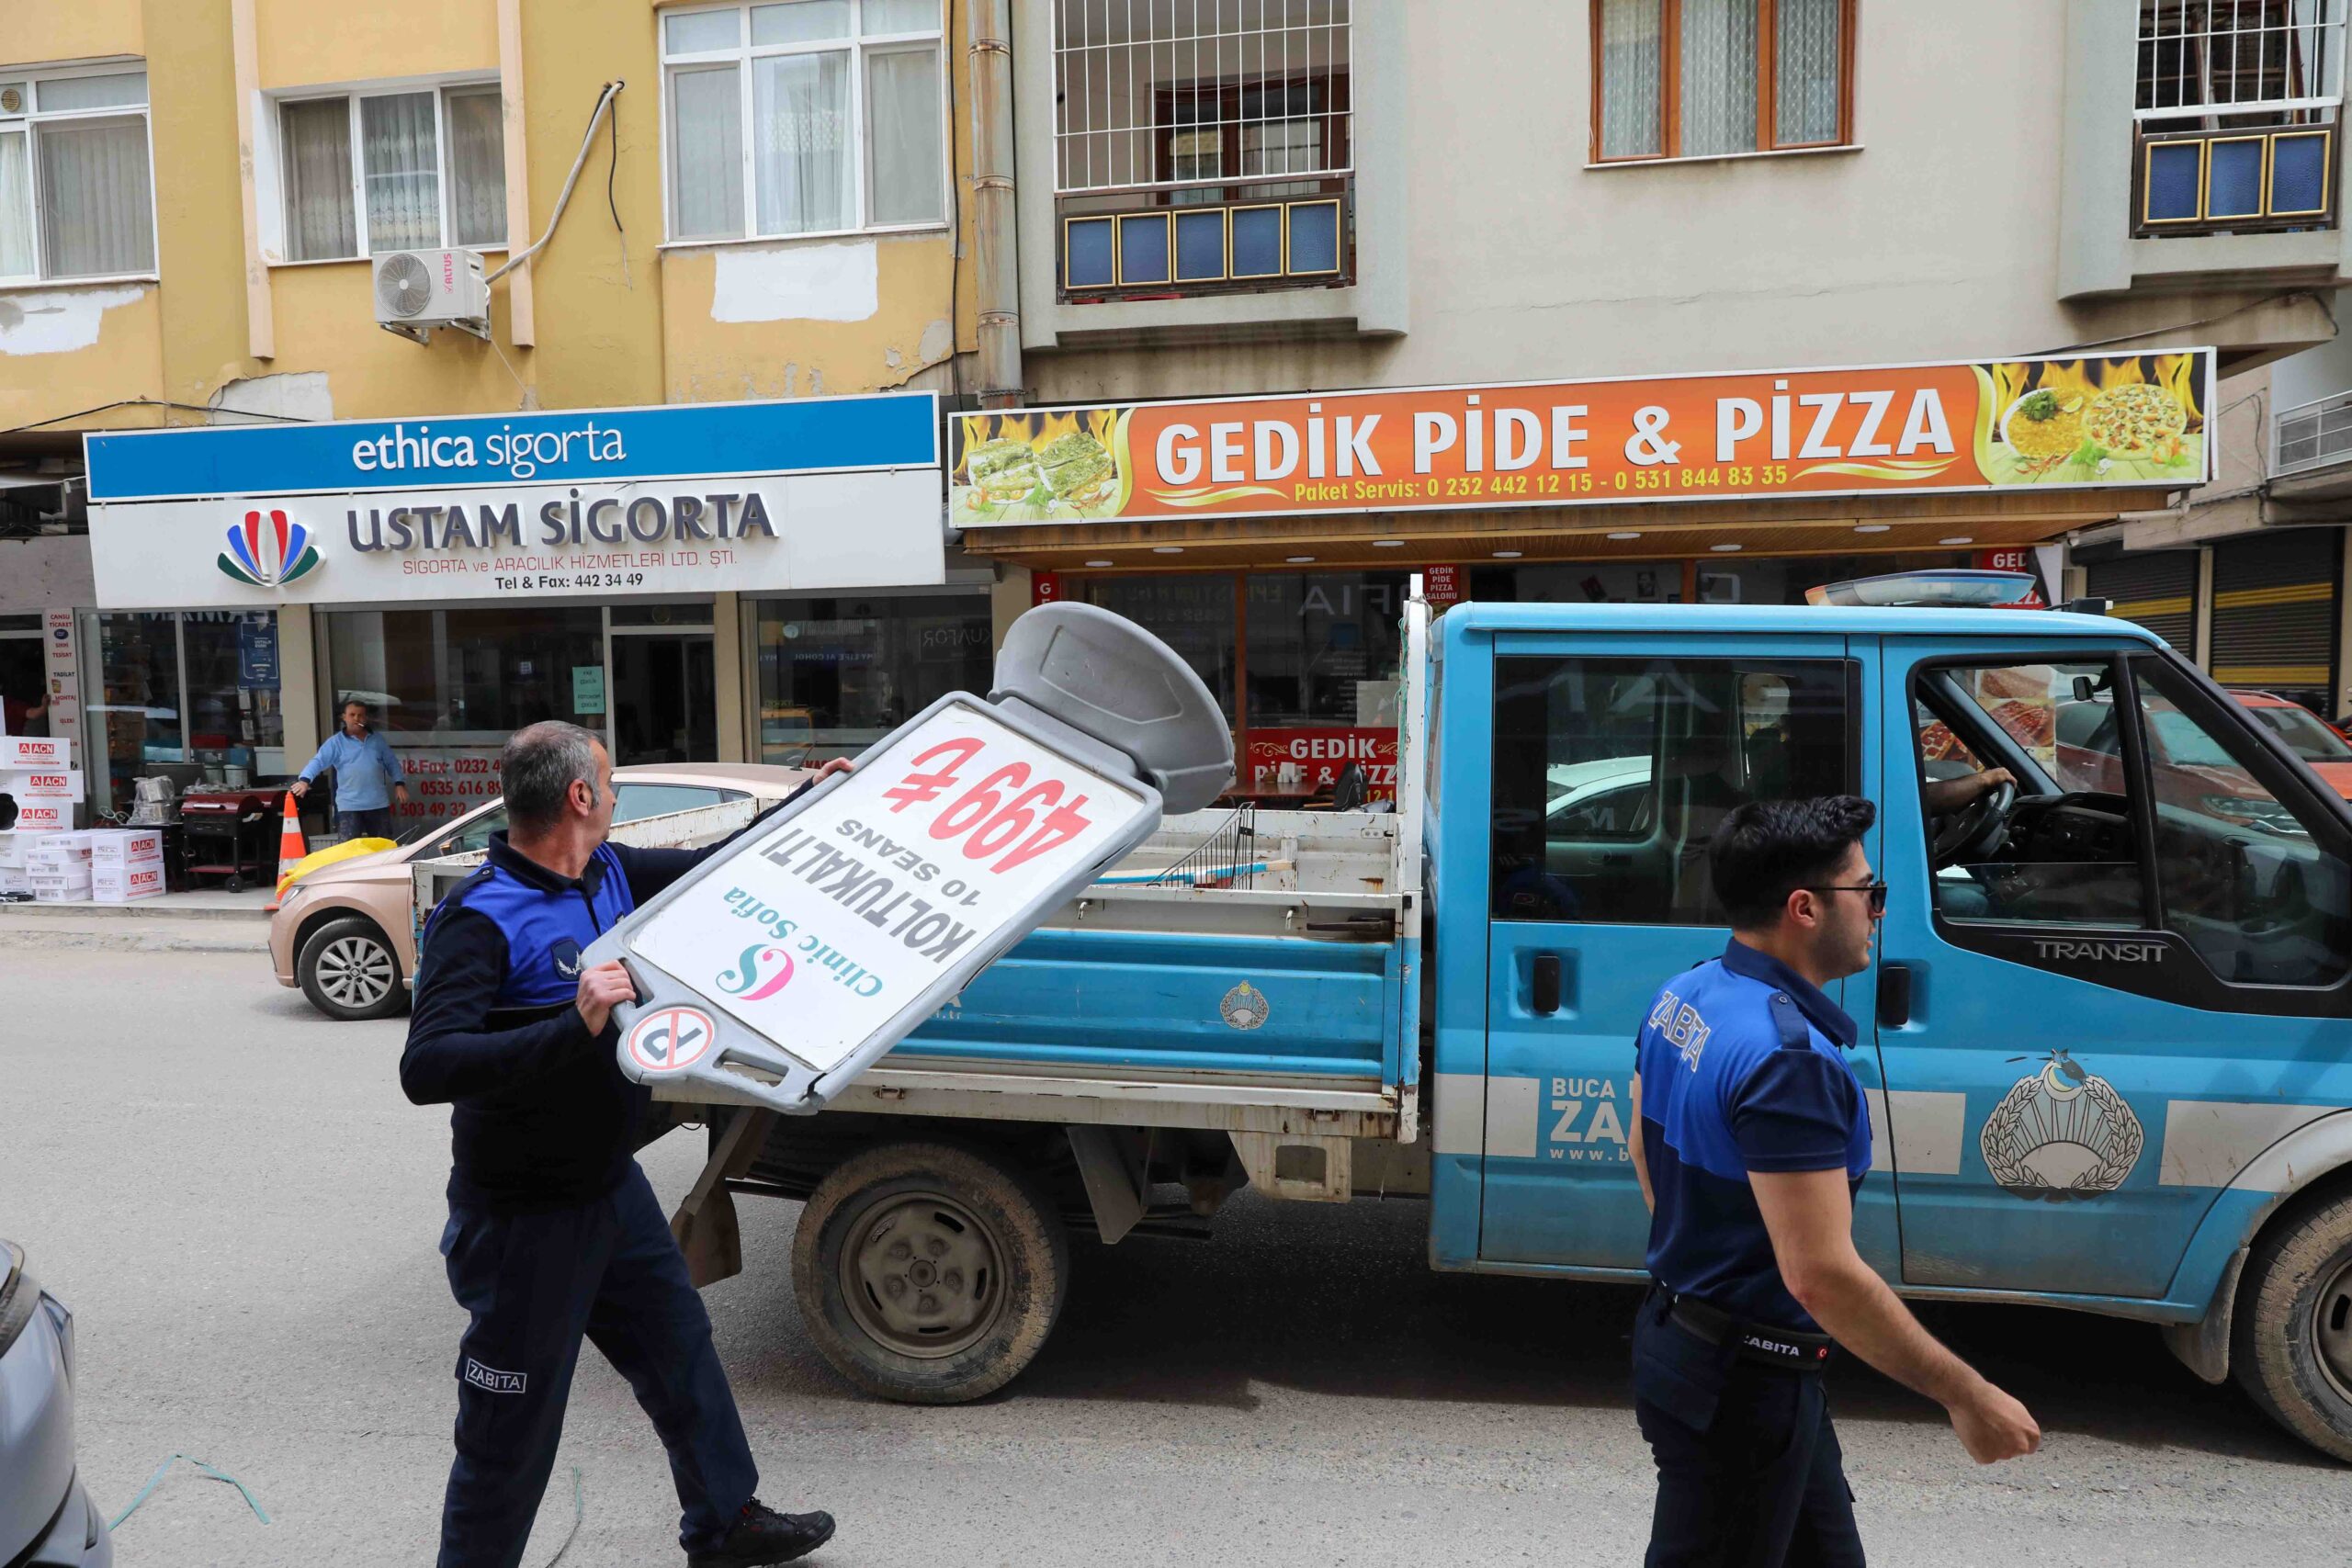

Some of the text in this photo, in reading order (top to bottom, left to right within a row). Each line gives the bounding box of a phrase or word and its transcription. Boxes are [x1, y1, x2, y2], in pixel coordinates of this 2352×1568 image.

[444, 253, 453, 285] ALTUS
[1155, 379, 1956, 486] GEDİK PİDE & PİZZA
[353, 421, 627, 479] ethica sigorta
[1295, 483, 1349, 502] Paket
[1354, 479, 1420, 501] Servis:
[1427, 478, 1439, 497] 0
[1446, 477, 1483, 496] 232
[1490, 476, 1527, 494] 442
[1537, 474, 1559, 493] 12
[1569, 473, 1592, 491] 15
[1614, 471, 1627, 491] 0
[1634, 469, 1671, 489] 531
[1680, 468, 1720, 487] 844
[1727, 467, 1753, 485] 83
[1761, 465, 1787, 484] 35
[347, 488, 780, 552] USTAM SİGORTA
[403, 547, 737, 575] SİGORTA ve ARACILIK HİZMETLERİ LTD. ŞTİ.
[1429, 566, 1454, 575] GEDİK
[495, 572, 643, 591] Tel & Fax: 442 34 49
[1430, 583, 1453, 592] PİZZA
[32, 744, 53, 754] ACN
[1290, 734, 1376, 760] GEDİK
[454, 759, 488, 773] 0232
[1318, 766, 1335, 784] &
[44, 776, 66, 786] ACN
[420, 781, 454, 795] 0535
[458, 781, 483, 795] 616
[35, 809, 57, 818] ACN
[929, 761, 1091, 874] 499
[140, 839, 155, 851] ACN
[835, 818, 980, 907] 10 SEANS
[140, 871, 157, 882] ACN
[759, 828, 977, 964] KOLTUKALTI
[723, 886, 883, 998] Clinic Sofia
[2034, 940, 2169, 962] TRANSIT
[1552, 1077, 1616, 1099] BUCA
[469, 1364, 521, 1390] ZABITA
